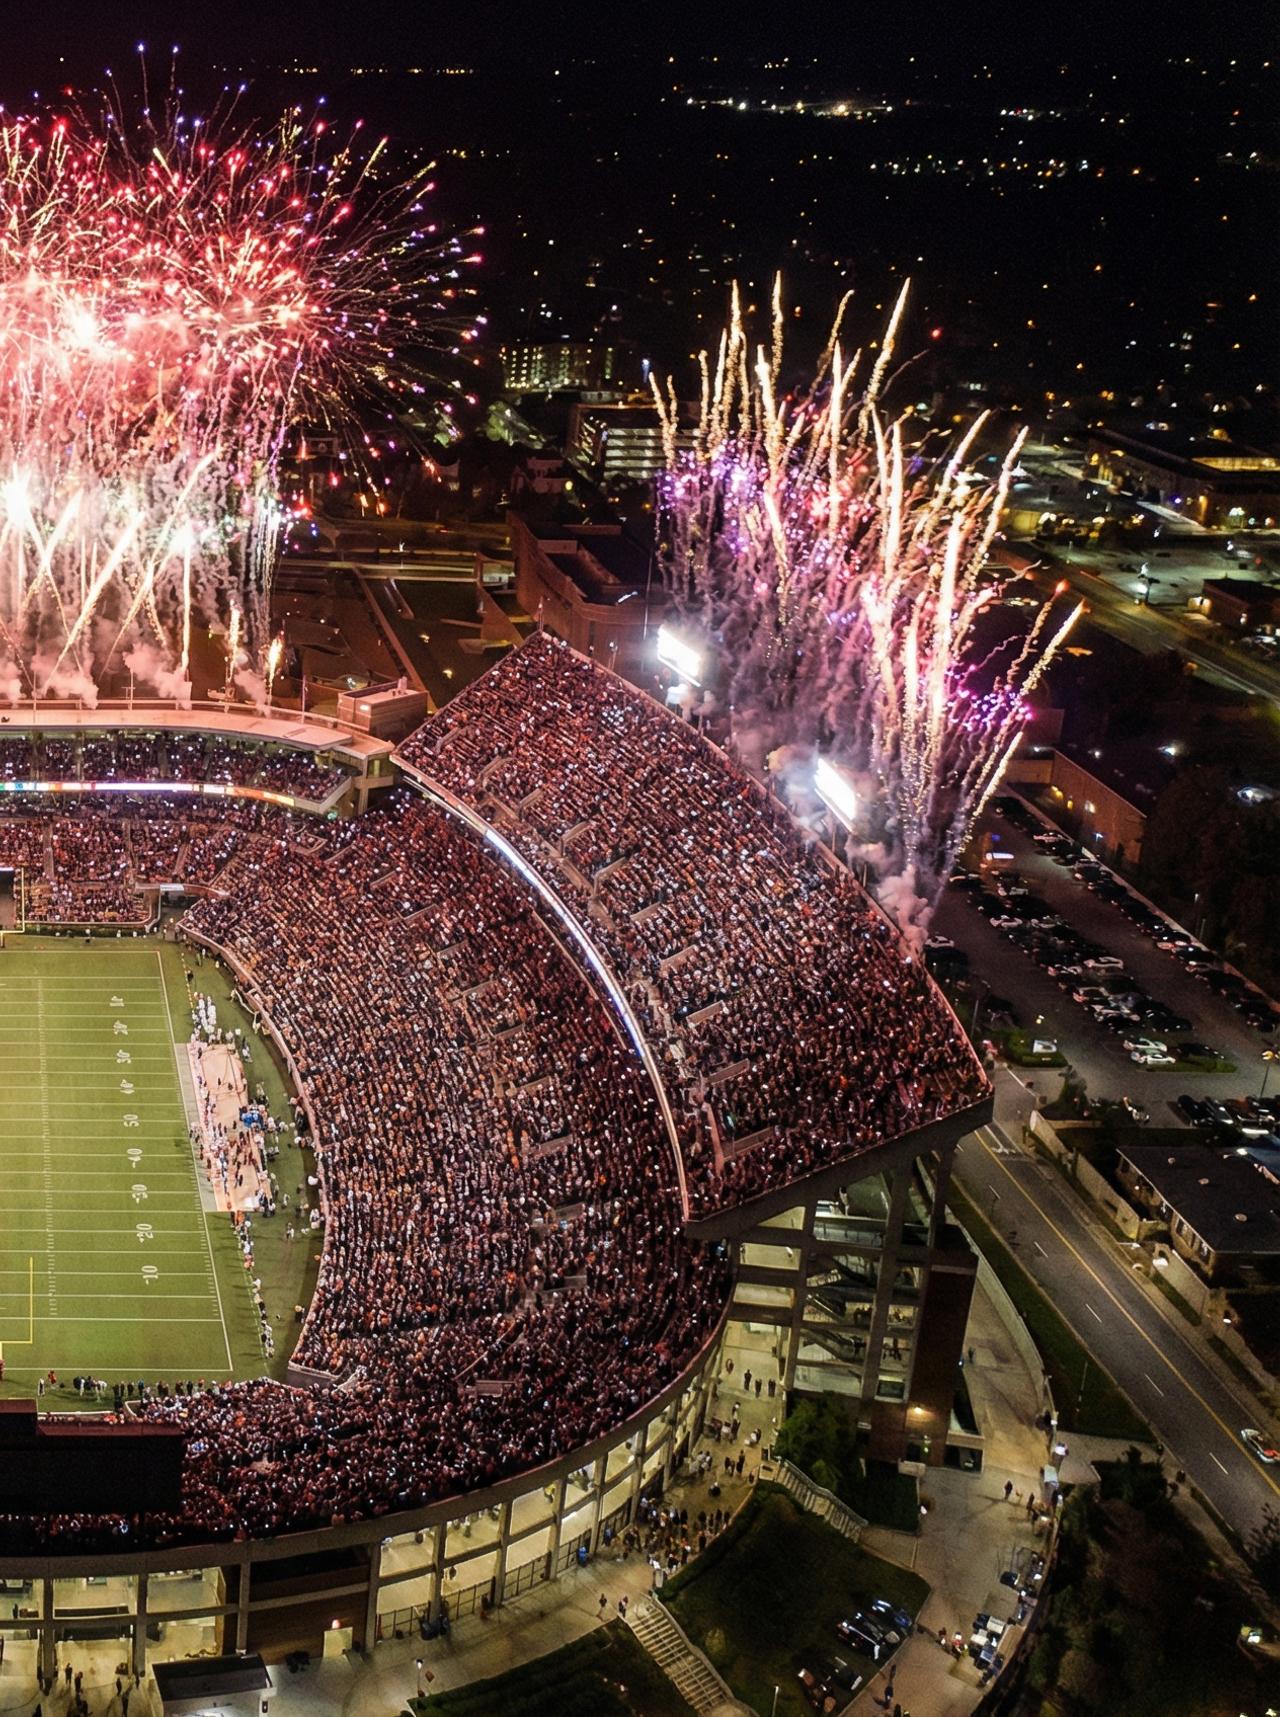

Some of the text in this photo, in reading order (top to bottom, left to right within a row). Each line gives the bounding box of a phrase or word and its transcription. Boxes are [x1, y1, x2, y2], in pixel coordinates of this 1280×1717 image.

[123, 1114, 139, 1127] 50
[131, 1184, 148, 1199] 30
[136, 1223, 154, 1239] 20
[141, 1265, 159, 1279] 10
